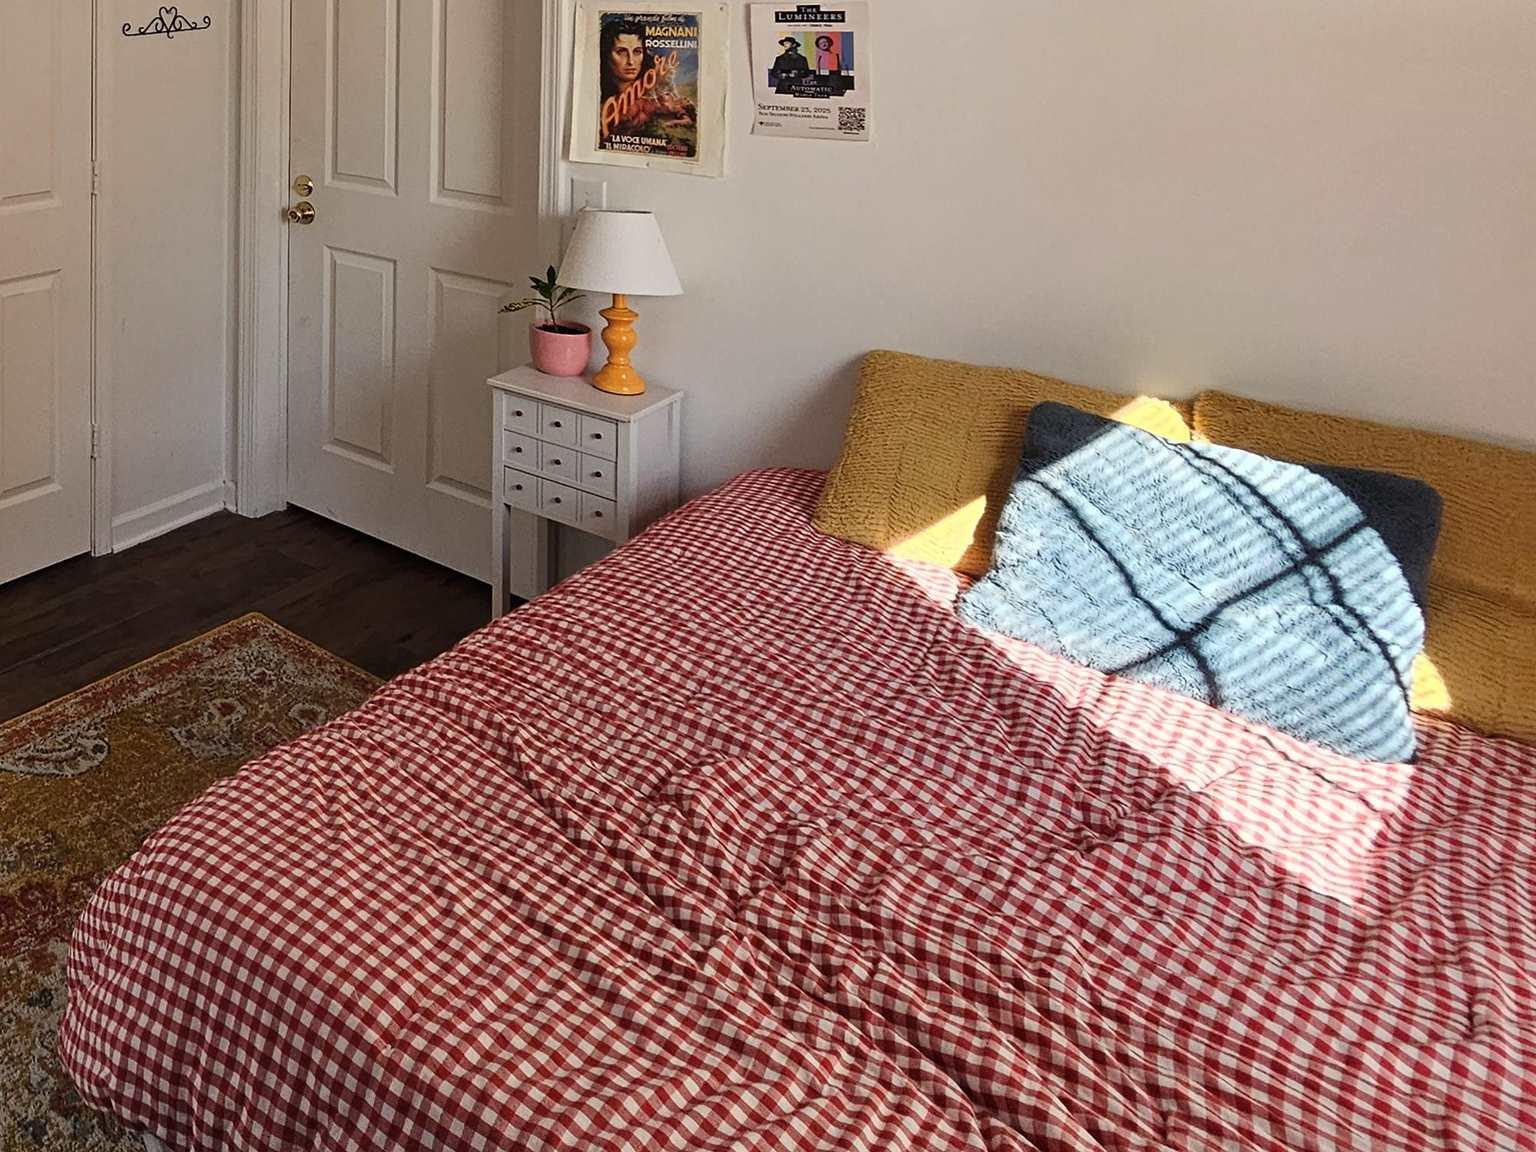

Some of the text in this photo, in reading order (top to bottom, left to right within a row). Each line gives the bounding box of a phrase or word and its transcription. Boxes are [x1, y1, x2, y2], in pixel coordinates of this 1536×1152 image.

[645, 26, 698, 38] MAGNANI
[645, 39, 697, 48] ROSSELLINI
[622, 135, 641, 145] VOCE
